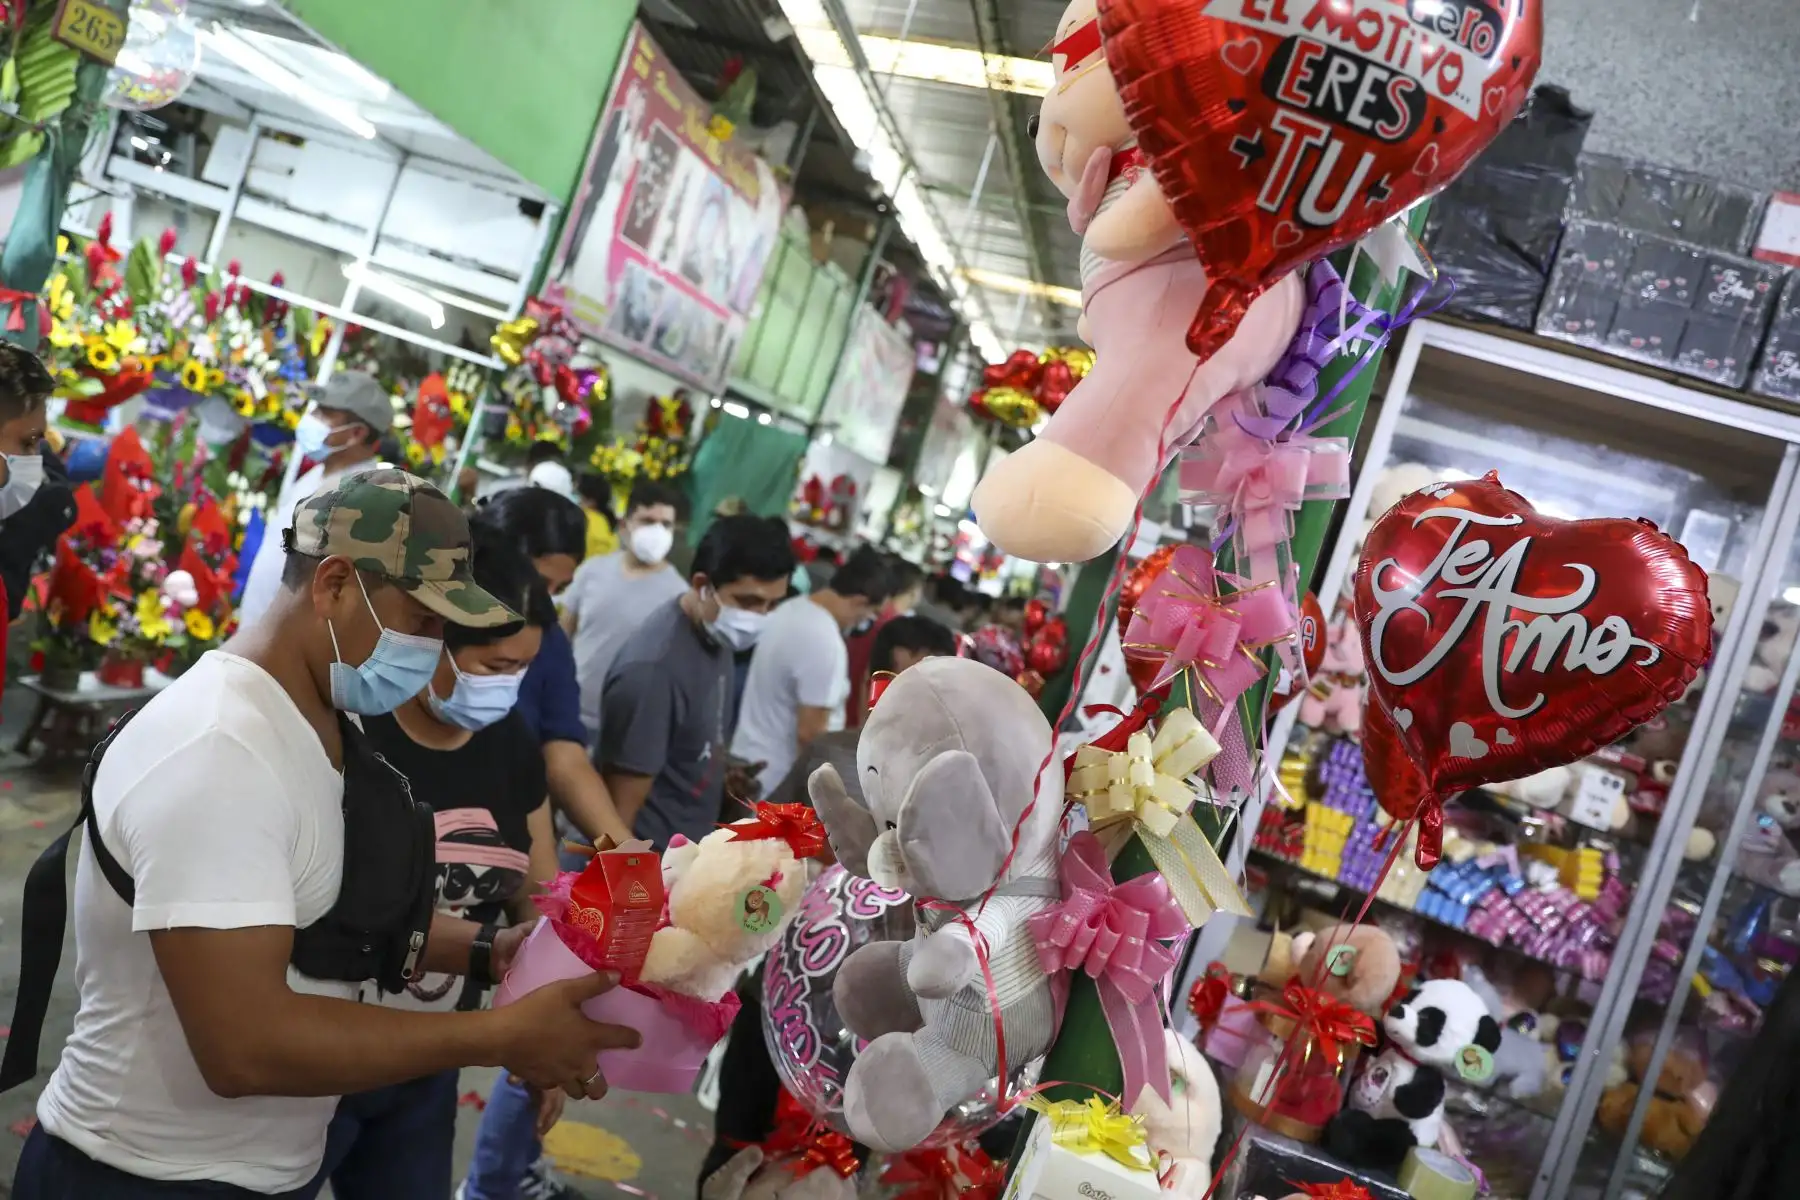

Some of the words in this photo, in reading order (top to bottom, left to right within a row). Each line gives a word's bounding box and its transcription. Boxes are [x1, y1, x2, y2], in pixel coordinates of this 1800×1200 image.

[68, 6, 117, 49] 265
[1276, 36, 1416, 140] ERES
[1256, 107, 1376, 226] TU
[1371, 507, 1524, 604] Te
[1371, 536, 1660, 719] Amo
